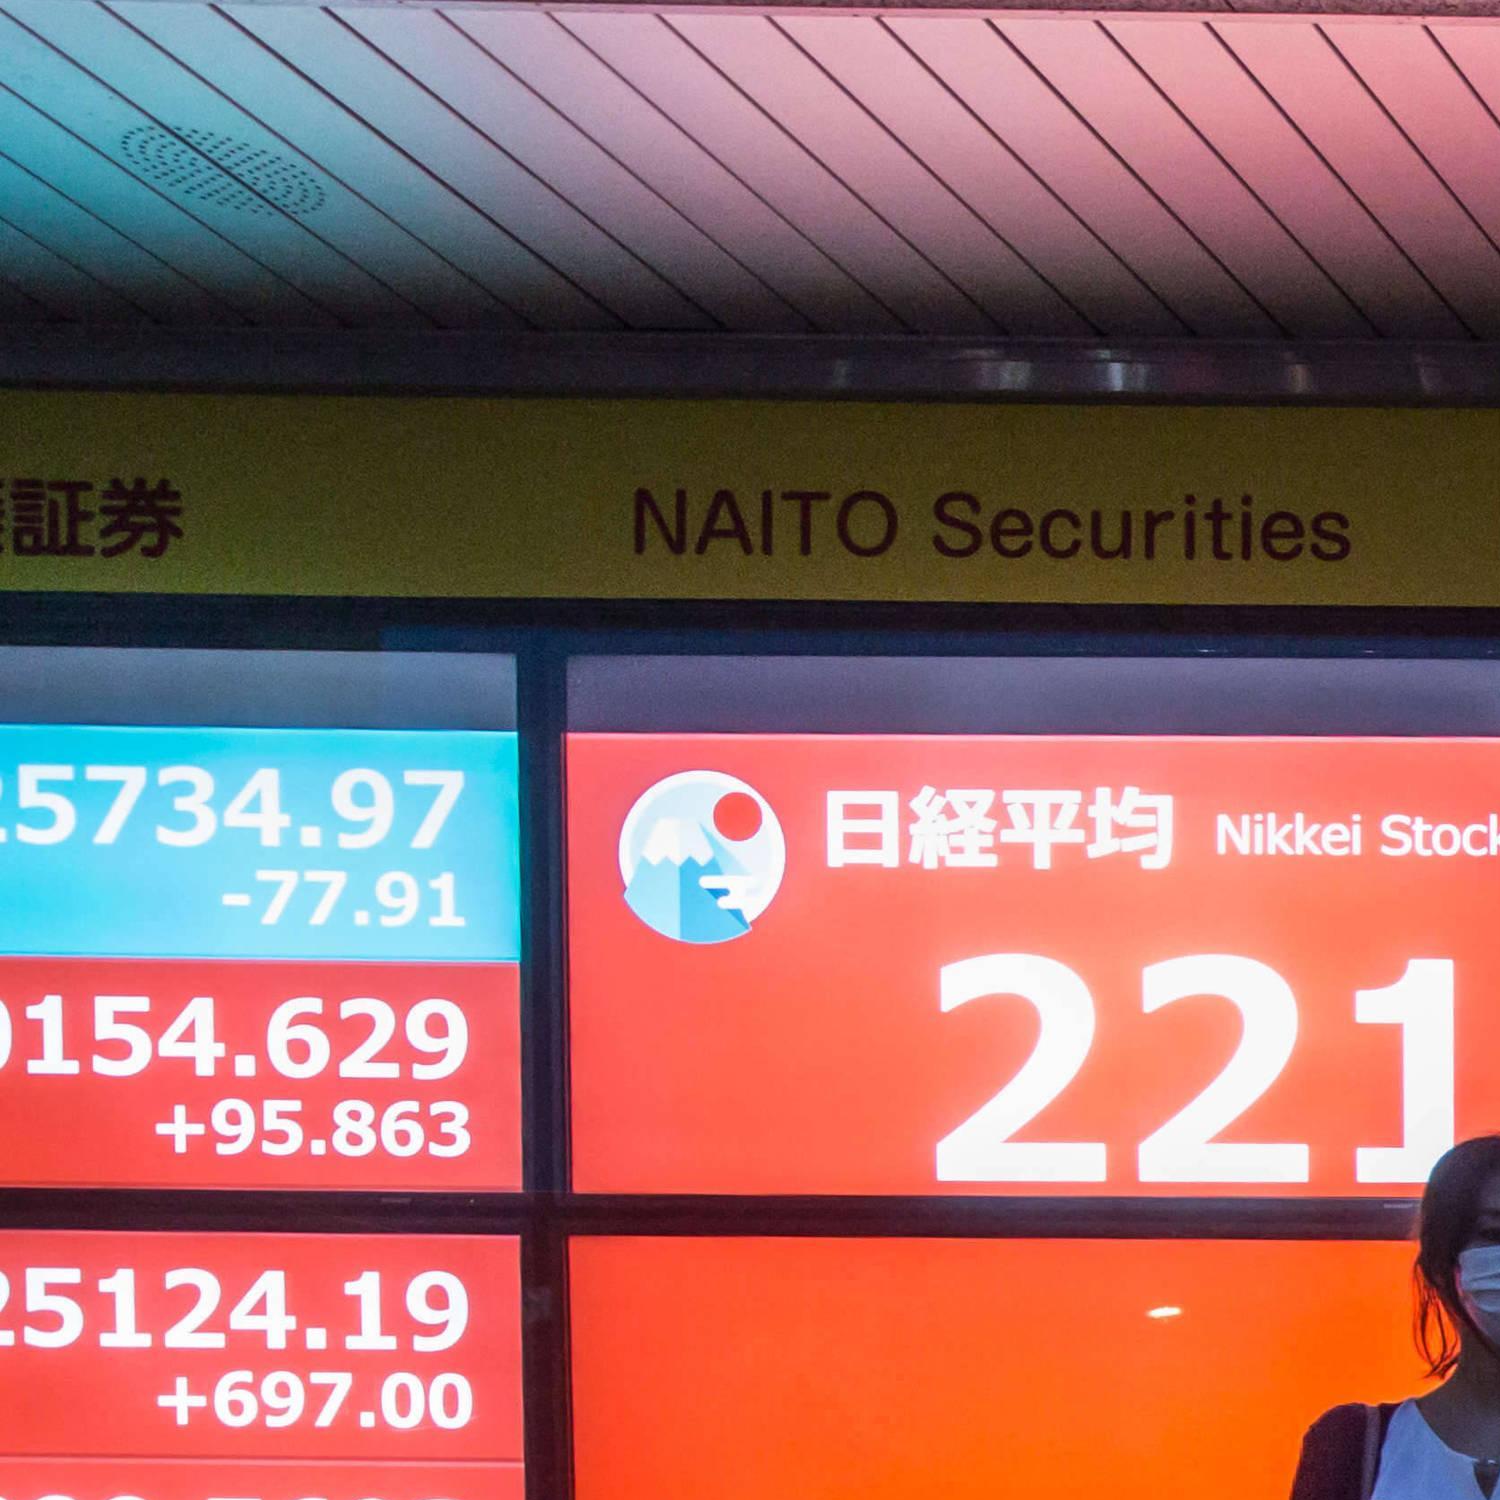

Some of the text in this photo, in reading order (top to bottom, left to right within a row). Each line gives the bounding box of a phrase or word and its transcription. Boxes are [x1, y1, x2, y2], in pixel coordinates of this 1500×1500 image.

[0, 477, 184, 559] 証券
[634, 488, 1352, 563] NAITO Securities
[0, 765, 464, 850] 5734.97
[825, 786, 1176, 872] 日経平均
[1216, 813, 1363, 858] Nikkei
[222, 870, 466, 927] -77.91
[0, 995, 470, 1081] 154.629
[155, 1098, 472, 1159] +95.863
[0, 1267, 470, 1354] 5124.19
[157, 1370, 474, 1430] +697.00
